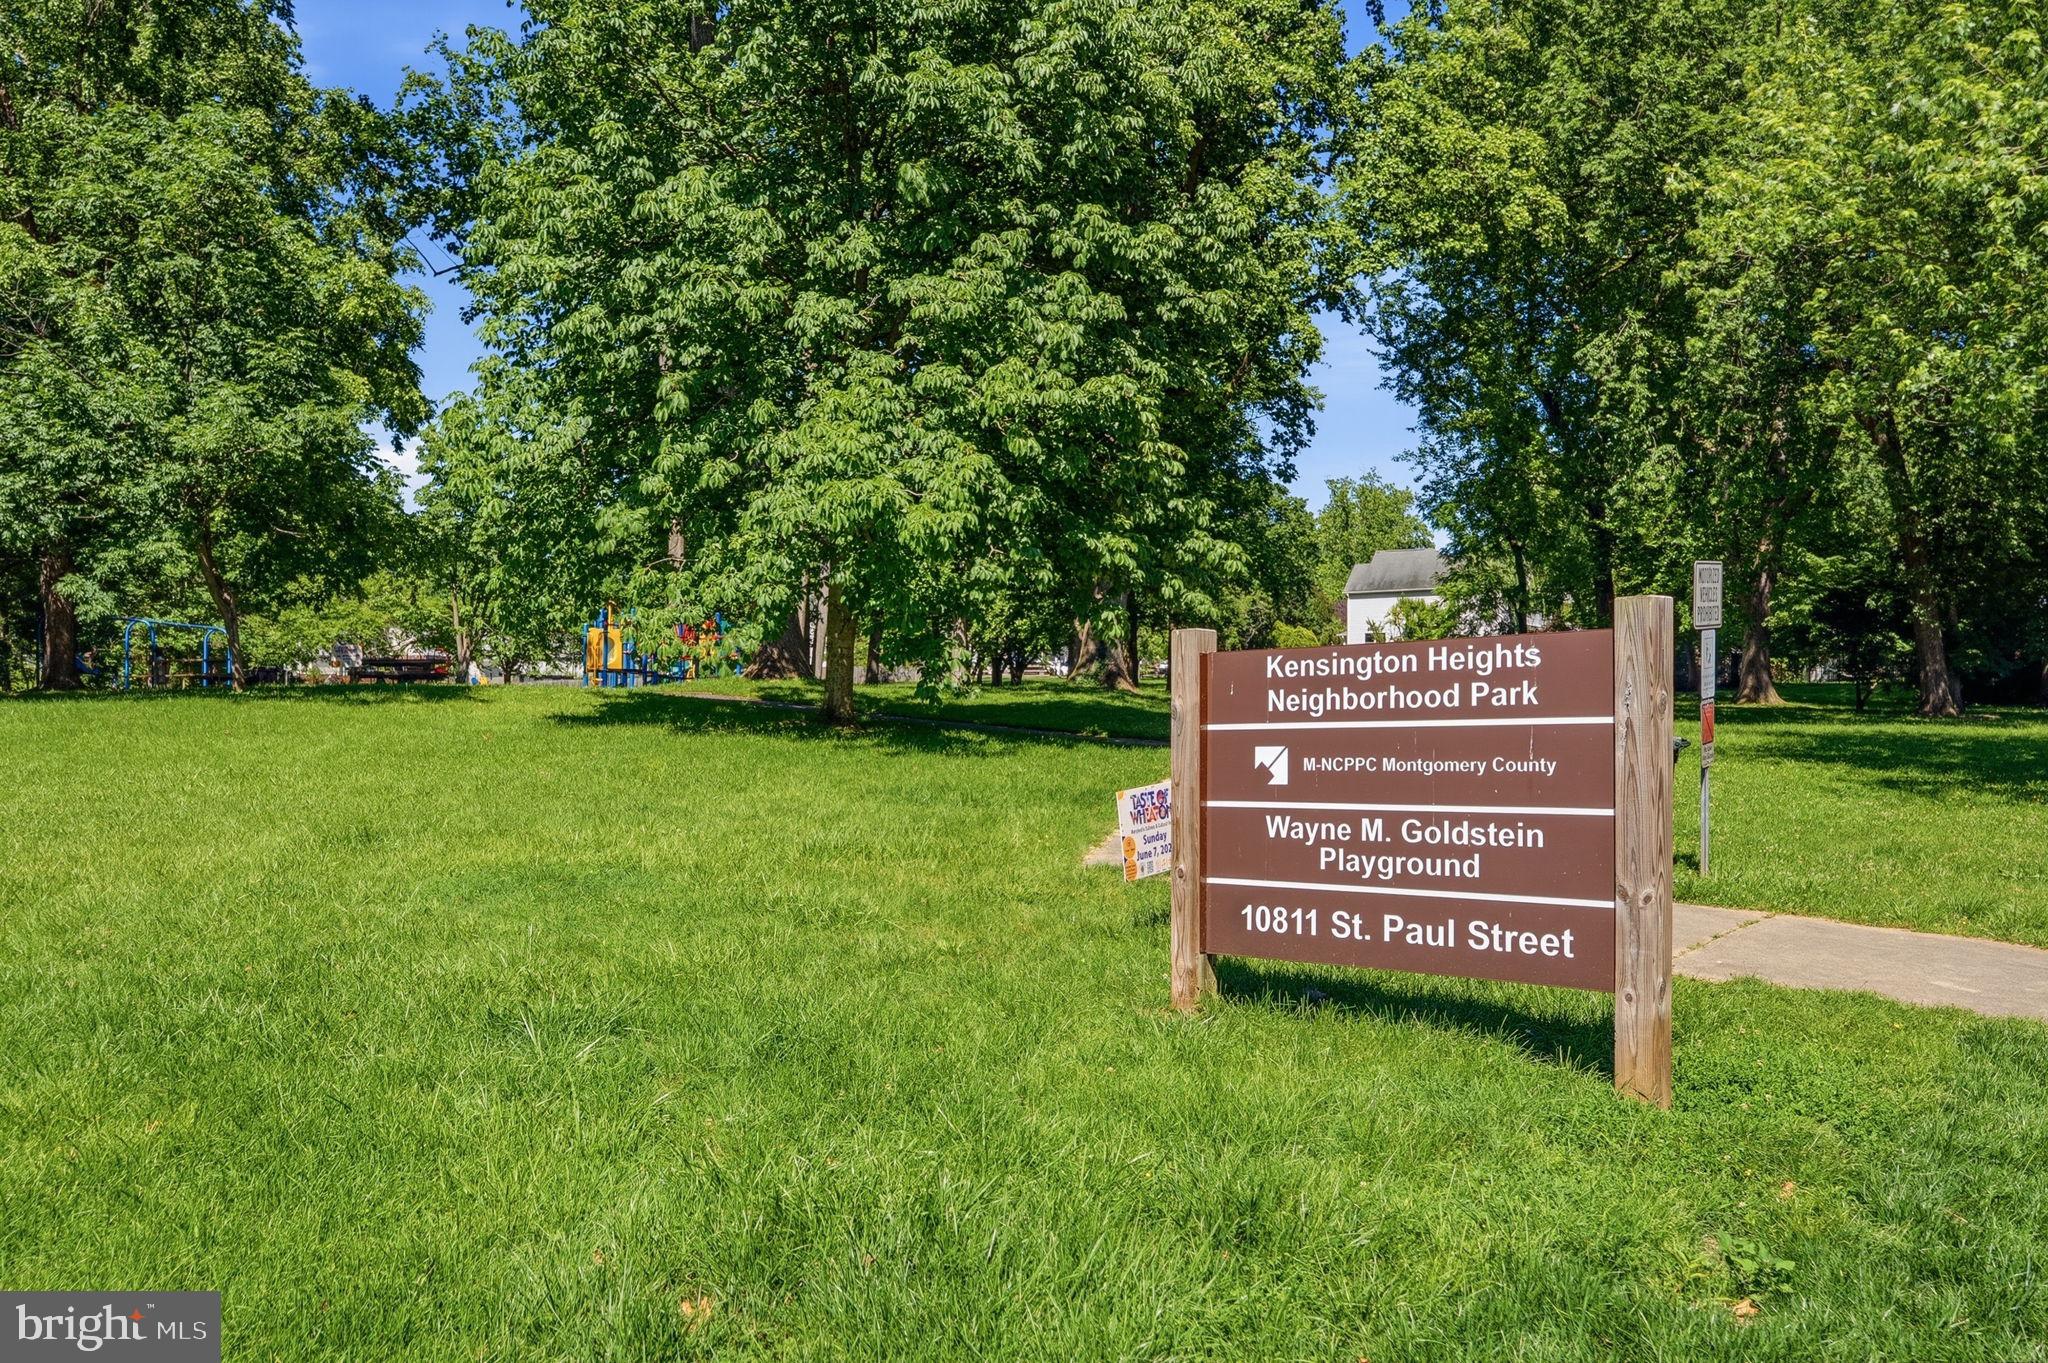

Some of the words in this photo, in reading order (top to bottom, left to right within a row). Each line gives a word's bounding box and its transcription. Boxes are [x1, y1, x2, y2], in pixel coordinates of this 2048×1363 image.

[1699, 587, 1718, 602] VEHICLES
[1266, 652, 1418, 681] Kensington
[1428, 642, 1542, 676] Heights
[1267, 683, 1460, 718] Neighborhood
[1471, 679, 1540, 707] Park
[1303, 757, 1377, 772] M-NCPPC
[1382, 758, 1487, 776] Montgomery
[1492, 757, 1557, 777] County
[1130, 791, 1156, 810] TASTE
[1156, 788, 1169, 805] OF
[1142, 831, 1167, 845] Sunday
[1265, 815, 1352, 846] Wayne
[1361, 818, 1391, 843] M.
[1401, 818, 1544, 848] Goldstein
[1137, 850, 1152, 861] June
[1153, 847, 1160, 858] 7,
[1160, 842, 1172, 855] 202
[1320, 846, 1480, 880] Playground
[1241, 904, 1317, 936] 10811
[1331, 910, 1371, 941] St.
[1383, 914, 1455, 948] Paul
[1467, 920, 1575, 959] Street
